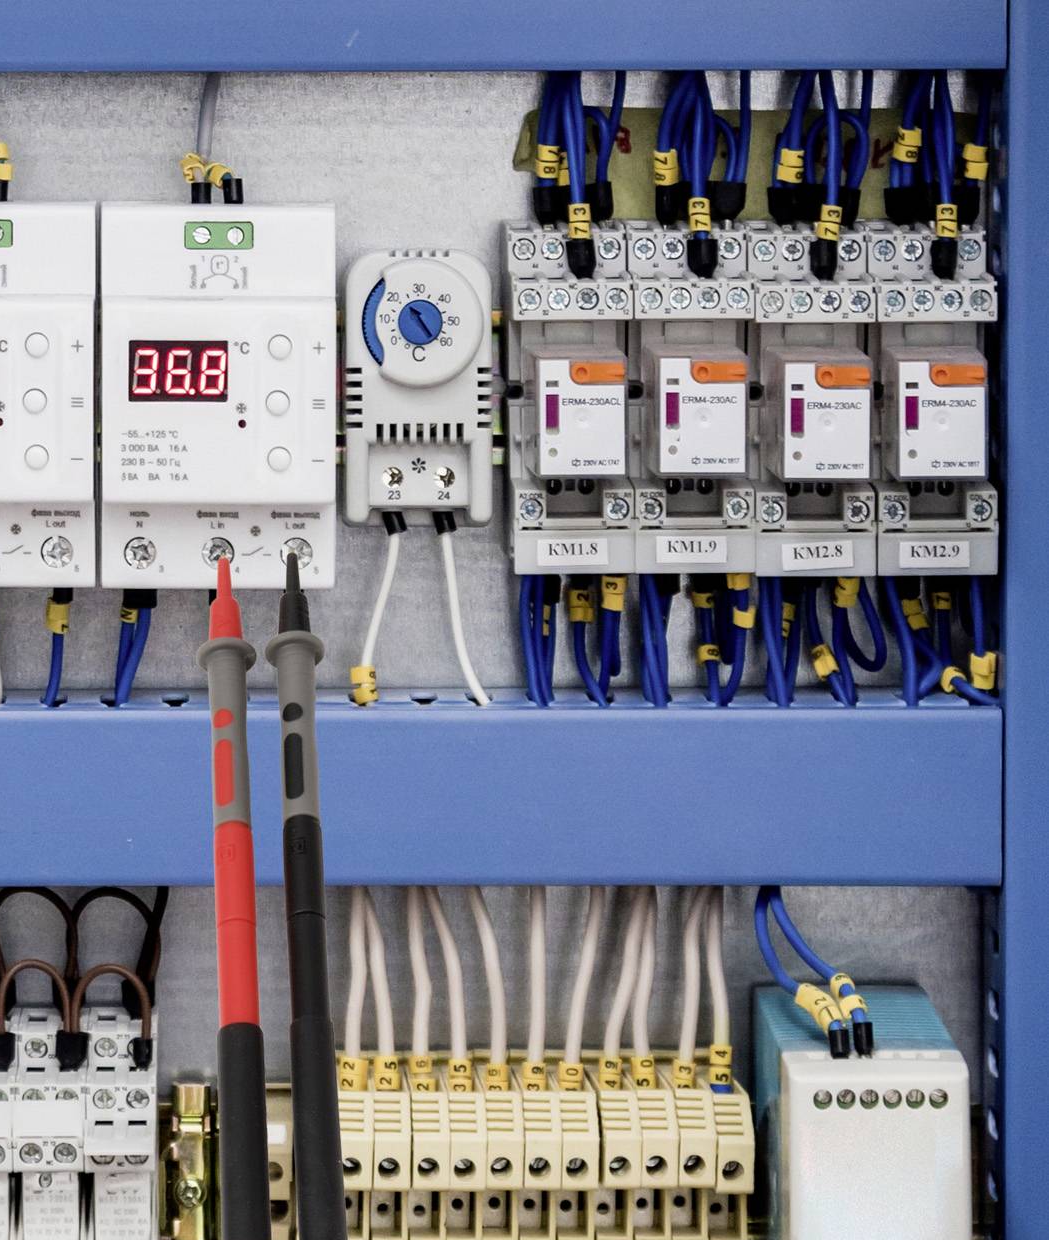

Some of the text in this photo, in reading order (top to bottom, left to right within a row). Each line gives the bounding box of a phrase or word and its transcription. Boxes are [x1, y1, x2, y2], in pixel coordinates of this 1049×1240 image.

[413, 284, 425, 293] 30
[387, 292, 399, 302] 20
[438, 293, 451, 303] 40
[379, 314, 390, 324] 10
[447, 316, 460, 326] 50
[391, 336, 398, 346] 0
[440, 337, 452, 347] 60
[132, 348, 227, 395] 36.8
[388, 491, 401, 500] 23
[438, 491, 450, 501] 24
[548, 542, 599, 559] KM1.8
[667, 540, 718, 556] KM1.9
[793, 544, 844, 562] KM2.8
[910, 543, 961, 560] KM2.9
